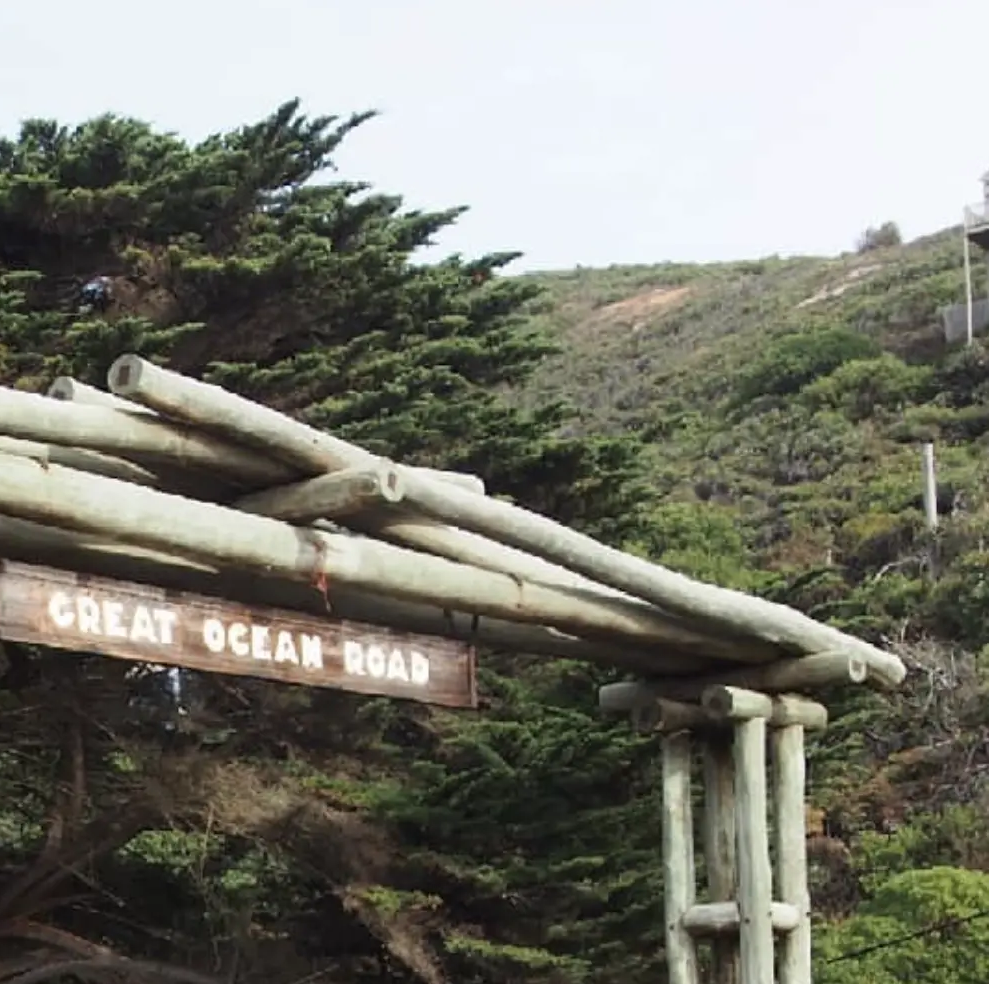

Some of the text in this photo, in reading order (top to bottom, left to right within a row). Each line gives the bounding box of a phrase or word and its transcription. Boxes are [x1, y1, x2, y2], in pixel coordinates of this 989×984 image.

[47, 592, 430, 684] GREAT OCEAN ROAD
